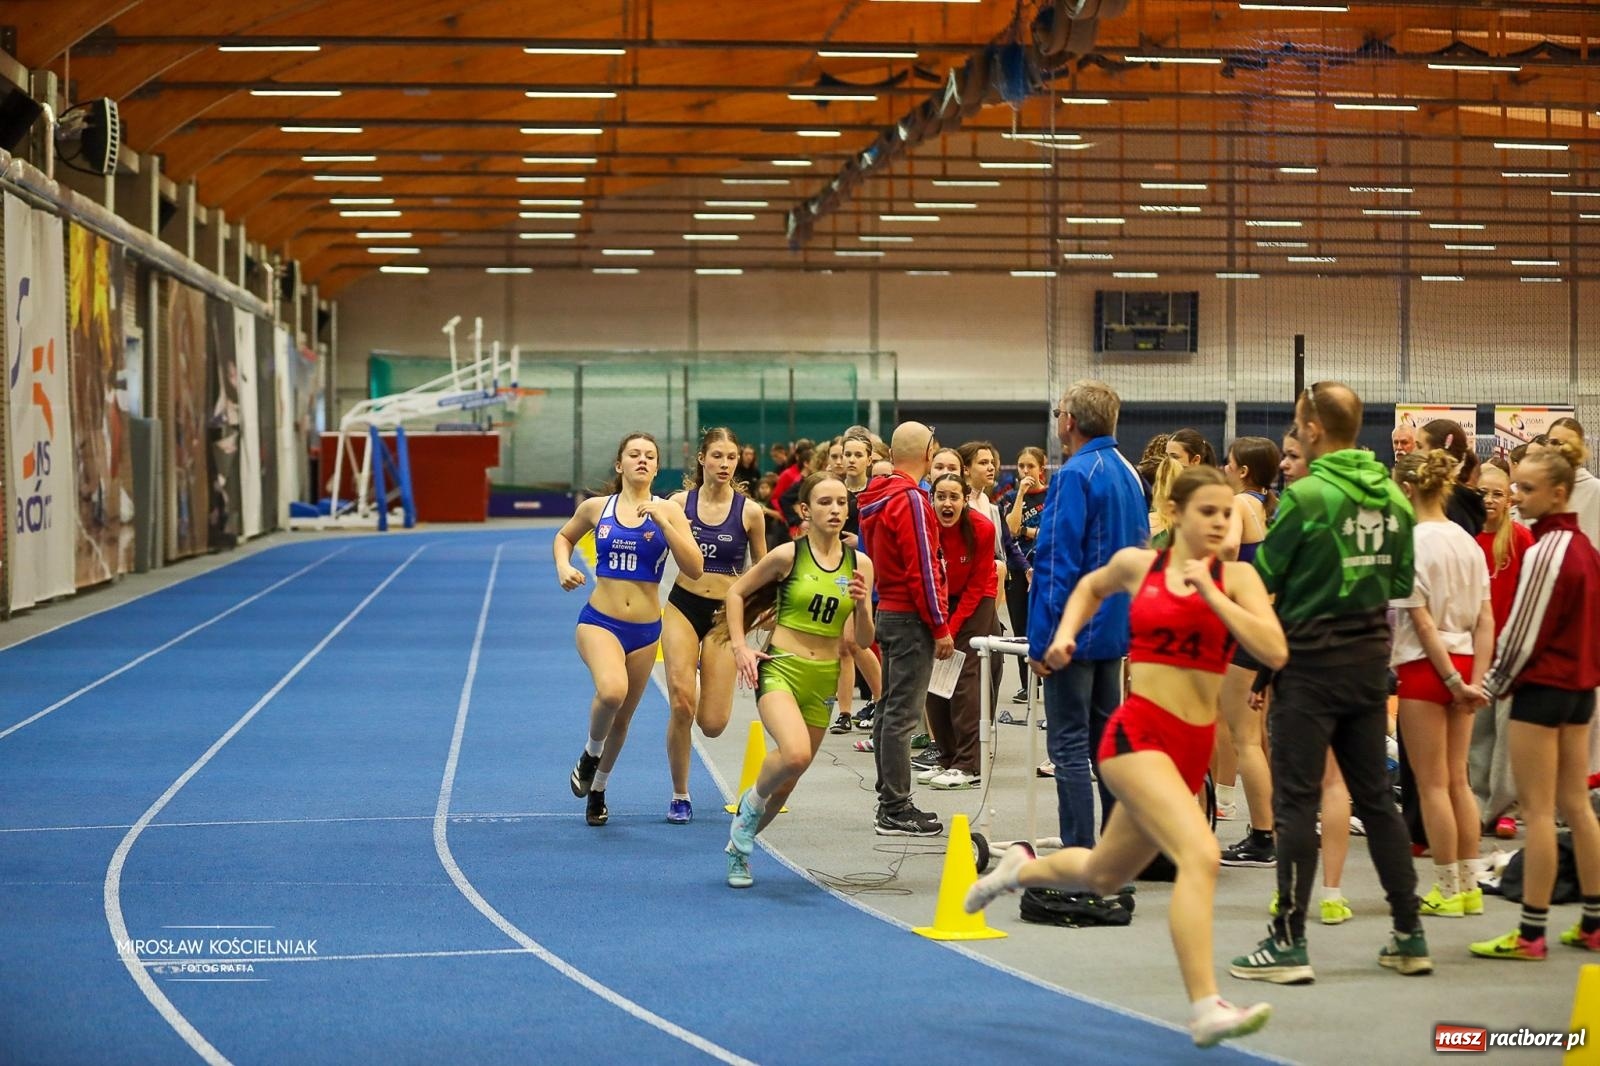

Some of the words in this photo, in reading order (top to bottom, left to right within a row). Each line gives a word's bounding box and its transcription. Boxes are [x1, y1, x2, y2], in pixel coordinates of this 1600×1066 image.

[609, 551, 637, 571] 310
[807, 593, 840, 624] 48
[1152, 627, 1202, 660] 24
